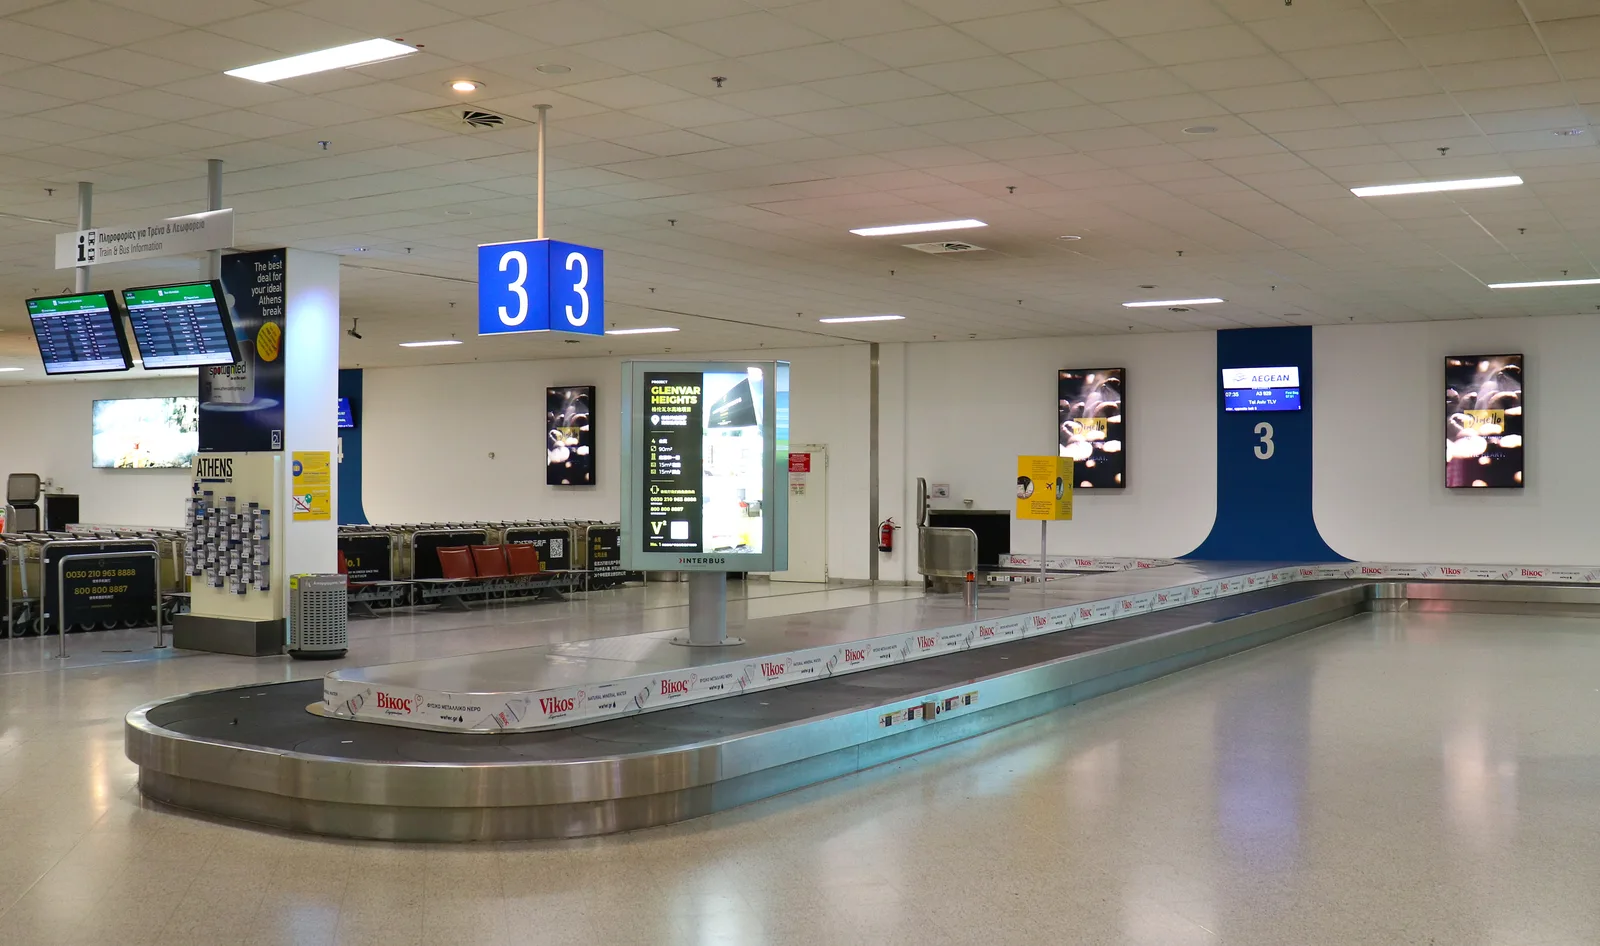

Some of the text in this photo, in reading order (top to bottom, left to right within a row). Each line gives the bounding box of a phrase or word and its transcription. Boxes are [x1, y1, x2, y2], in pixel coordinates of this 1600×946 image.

[99, 220, 205, 243] Πληροφορίες για Τρένα & Λεωφορεία
[100, 242, 162, 256] Train & Bus Information
[254, 260, 282, 272] The best
[257, 272, 282, 283] deal for
[252, 283, 282, 297] your ideal
[498, 250, 528, 326] 3
[566, 252, 590, 326] 3
[259, 295, 282, 305] Athens
[262, 306, 282, 316] break
[1252, 374, 1290, 382] AEGEAN
[651, 386, 701, 395] GLENVAR
[651, 396, 698, 404] HEIGHTS
[1254, 422, 1274, 460] 3
[197, 458, 232, 477] ATHENS
[66, 570, 87, 578] 0030
[117, 568, 136, 576] 8888
[74, 587, 90, 595] 800
[917, 636, 934, 648] Vikos
[845, 648, 865, 662] Βίκος
[761, 663, 784, 677] Vikos
[661, 679, 688, 695] Βίκος
[376, 692, 412, 714] Βίκος
[539, 696, 574, 714] Vikos
